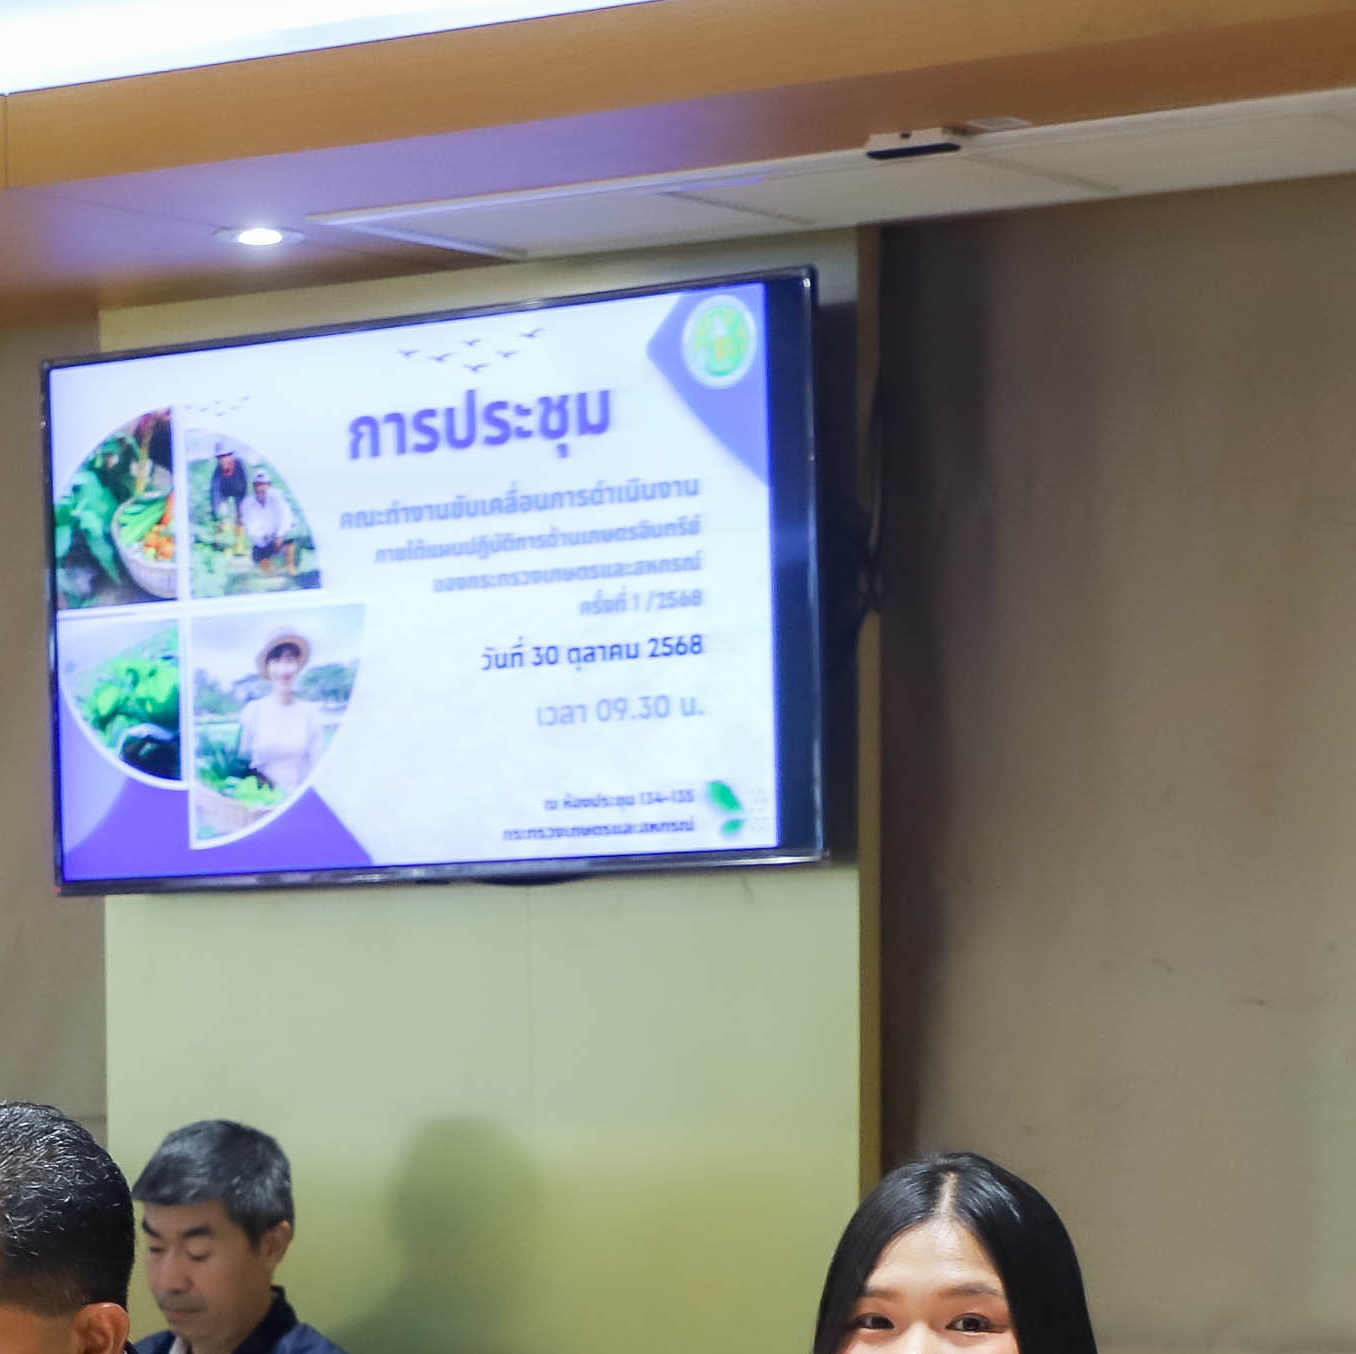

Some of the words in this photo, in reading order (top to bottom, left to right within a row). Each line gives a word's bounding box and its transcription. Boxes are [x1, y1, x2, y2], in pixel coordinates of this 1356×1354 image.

[348, 388, 612, 461] การประชุม
[481, 636, 525, 671] วันที่
[532, 645, 559, 666] 30
[566, 642, 640, 671] ตุลาคม
[646, 634, 704, 659] 2568
[536, 703, 588, 727] เวลา
[595, 694, 671, 723] 09.30
[680, 696, 706, 716] น.
